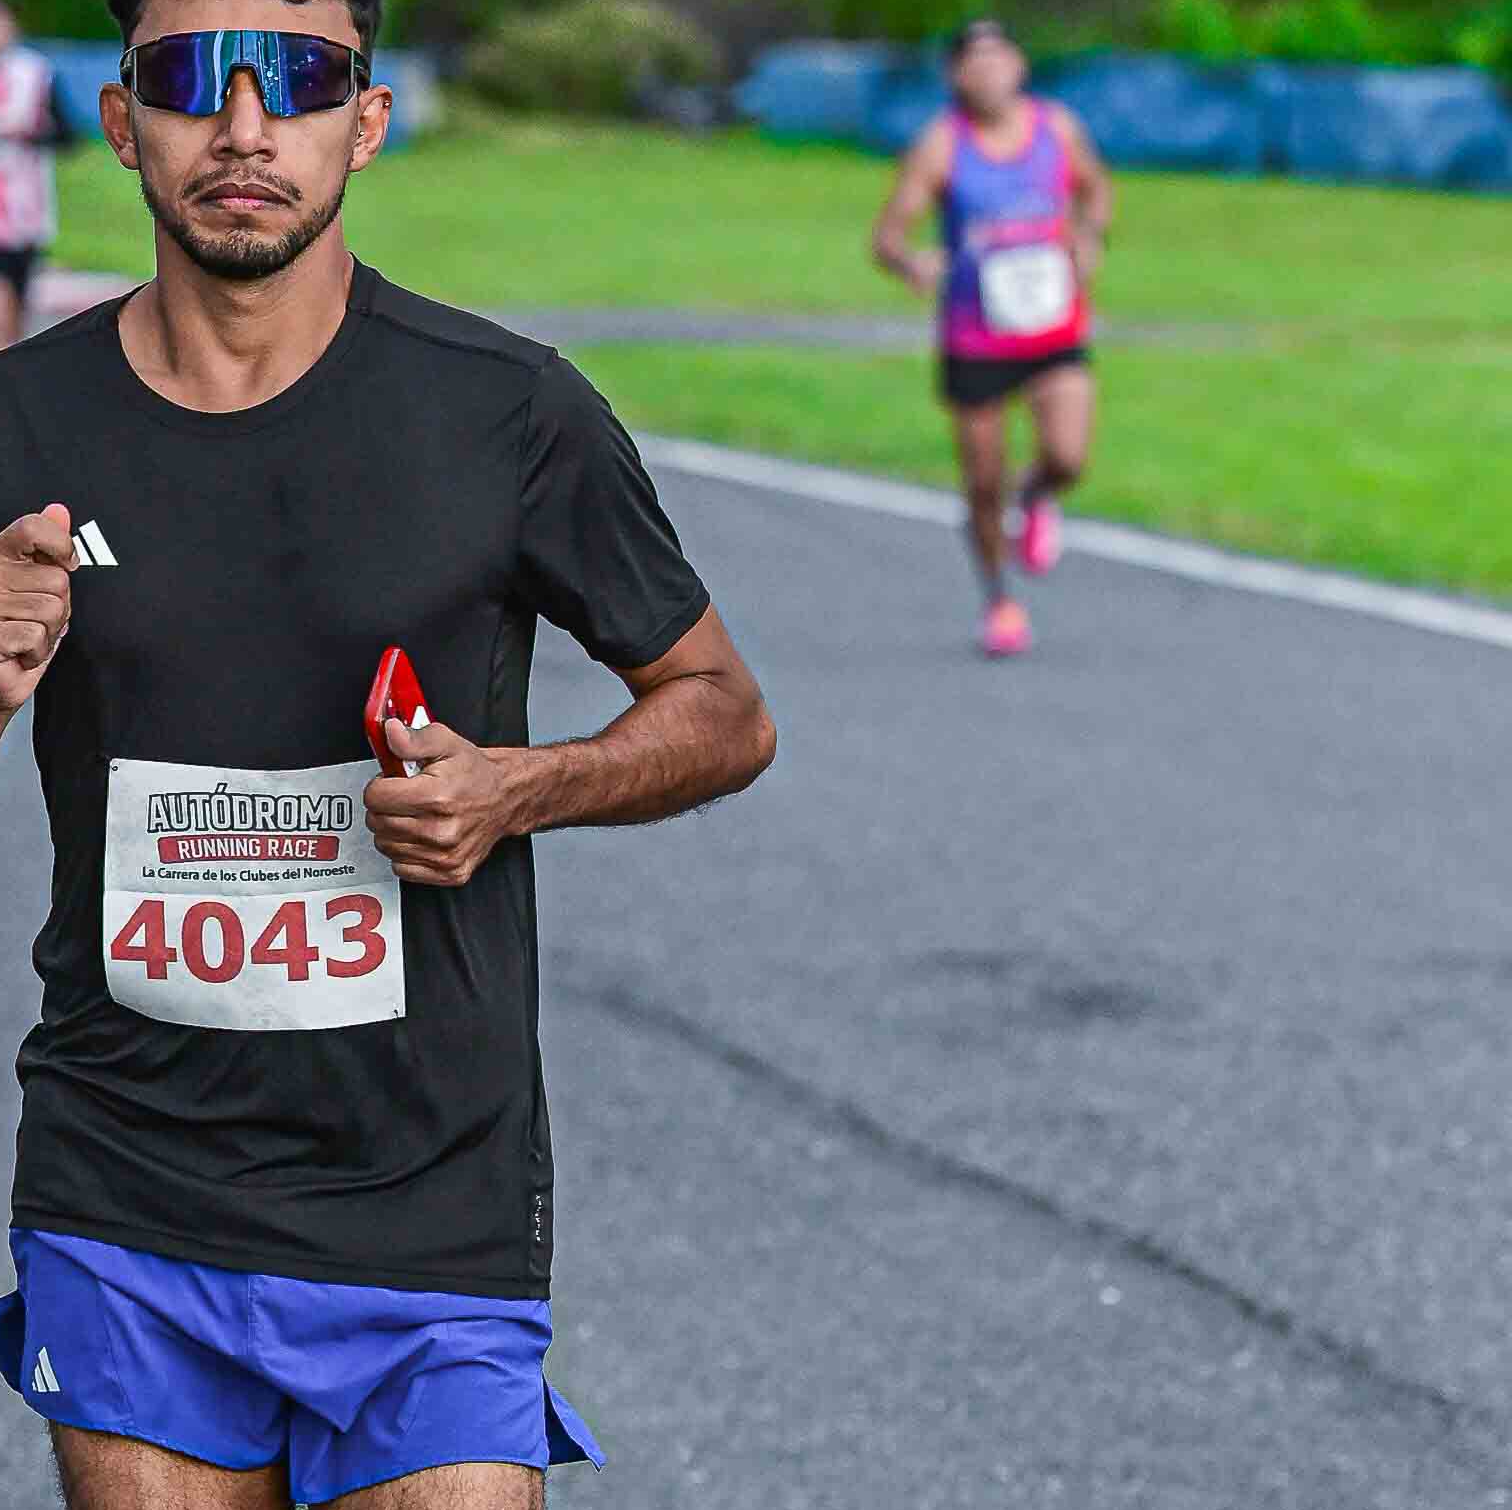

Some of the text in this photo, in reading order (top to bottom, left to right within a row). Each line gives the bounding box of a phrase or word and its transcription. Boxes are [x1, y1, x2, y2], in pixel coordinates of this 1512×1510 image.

[147, 782, 353, 833] AUTÓDROMO
[177, 838, 318, 860] RUNNING RACE
[142, 864, 356, 882] La Carrera de los Clubes del Noroeste
[110, 893, 387, 984] 4043
